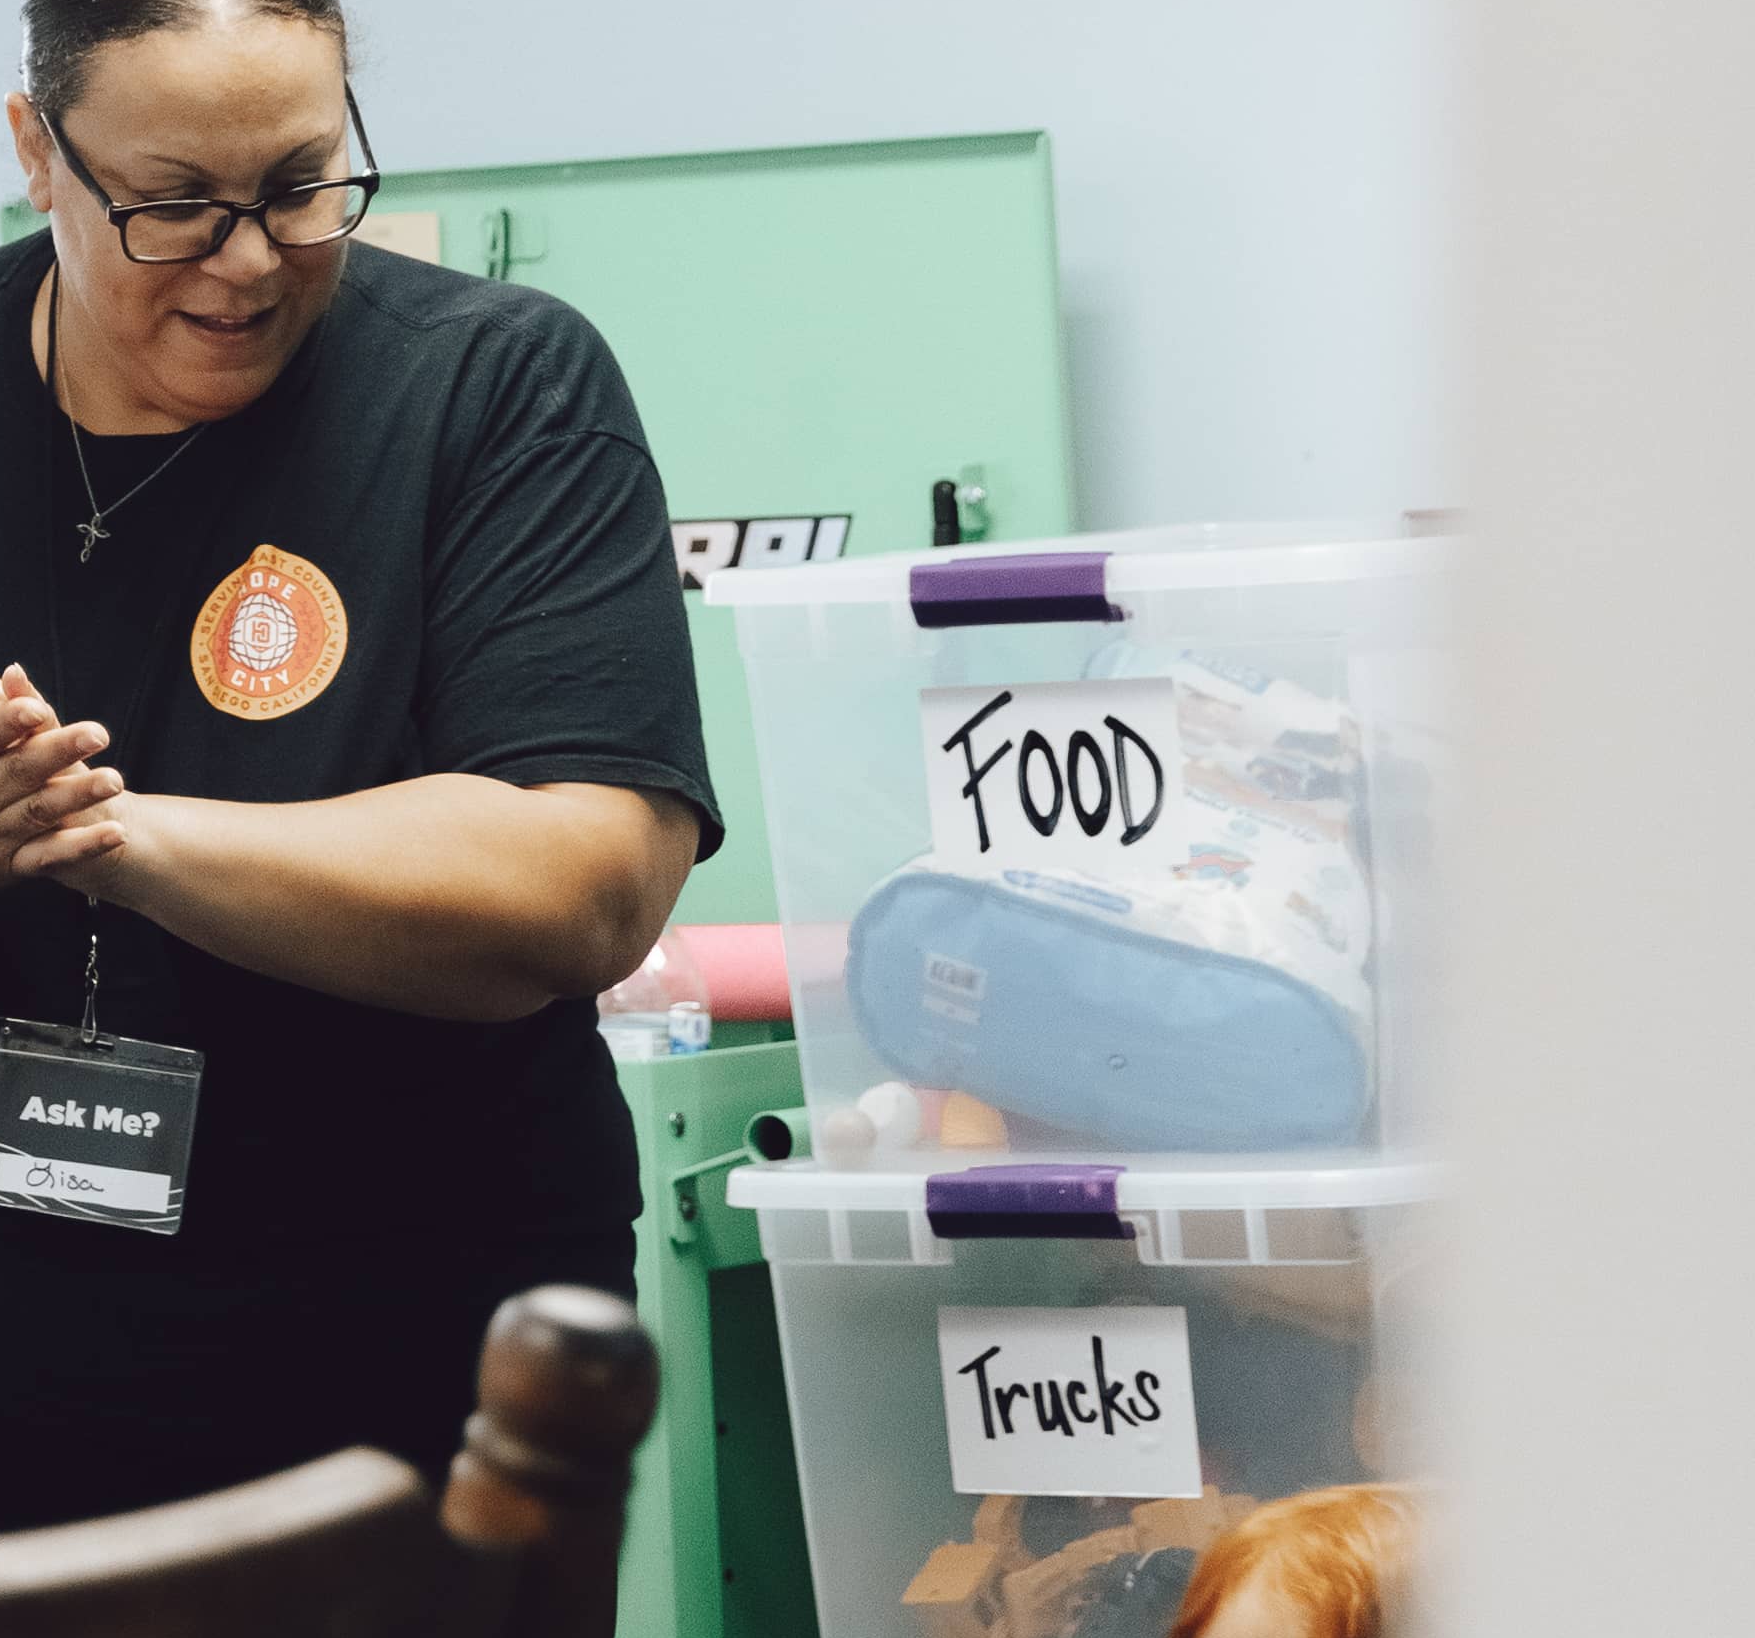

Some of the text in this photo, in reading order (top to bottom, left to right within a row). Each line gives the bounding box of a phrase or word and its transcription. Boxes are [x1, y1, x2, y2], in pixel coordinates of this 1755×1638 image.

[200, 574, 243, 634] SERVIN
[293, 565, 338, 623] COUNTY
[231, 668, 290, 693] CITY
[260, 641, 339, 712] CALIFORNIA
[942, 691, 1165, 854] FOOD
[19, 1095, 161, 1138] Ask Me?
[957, 1335, 1161, 1440] Trucks
